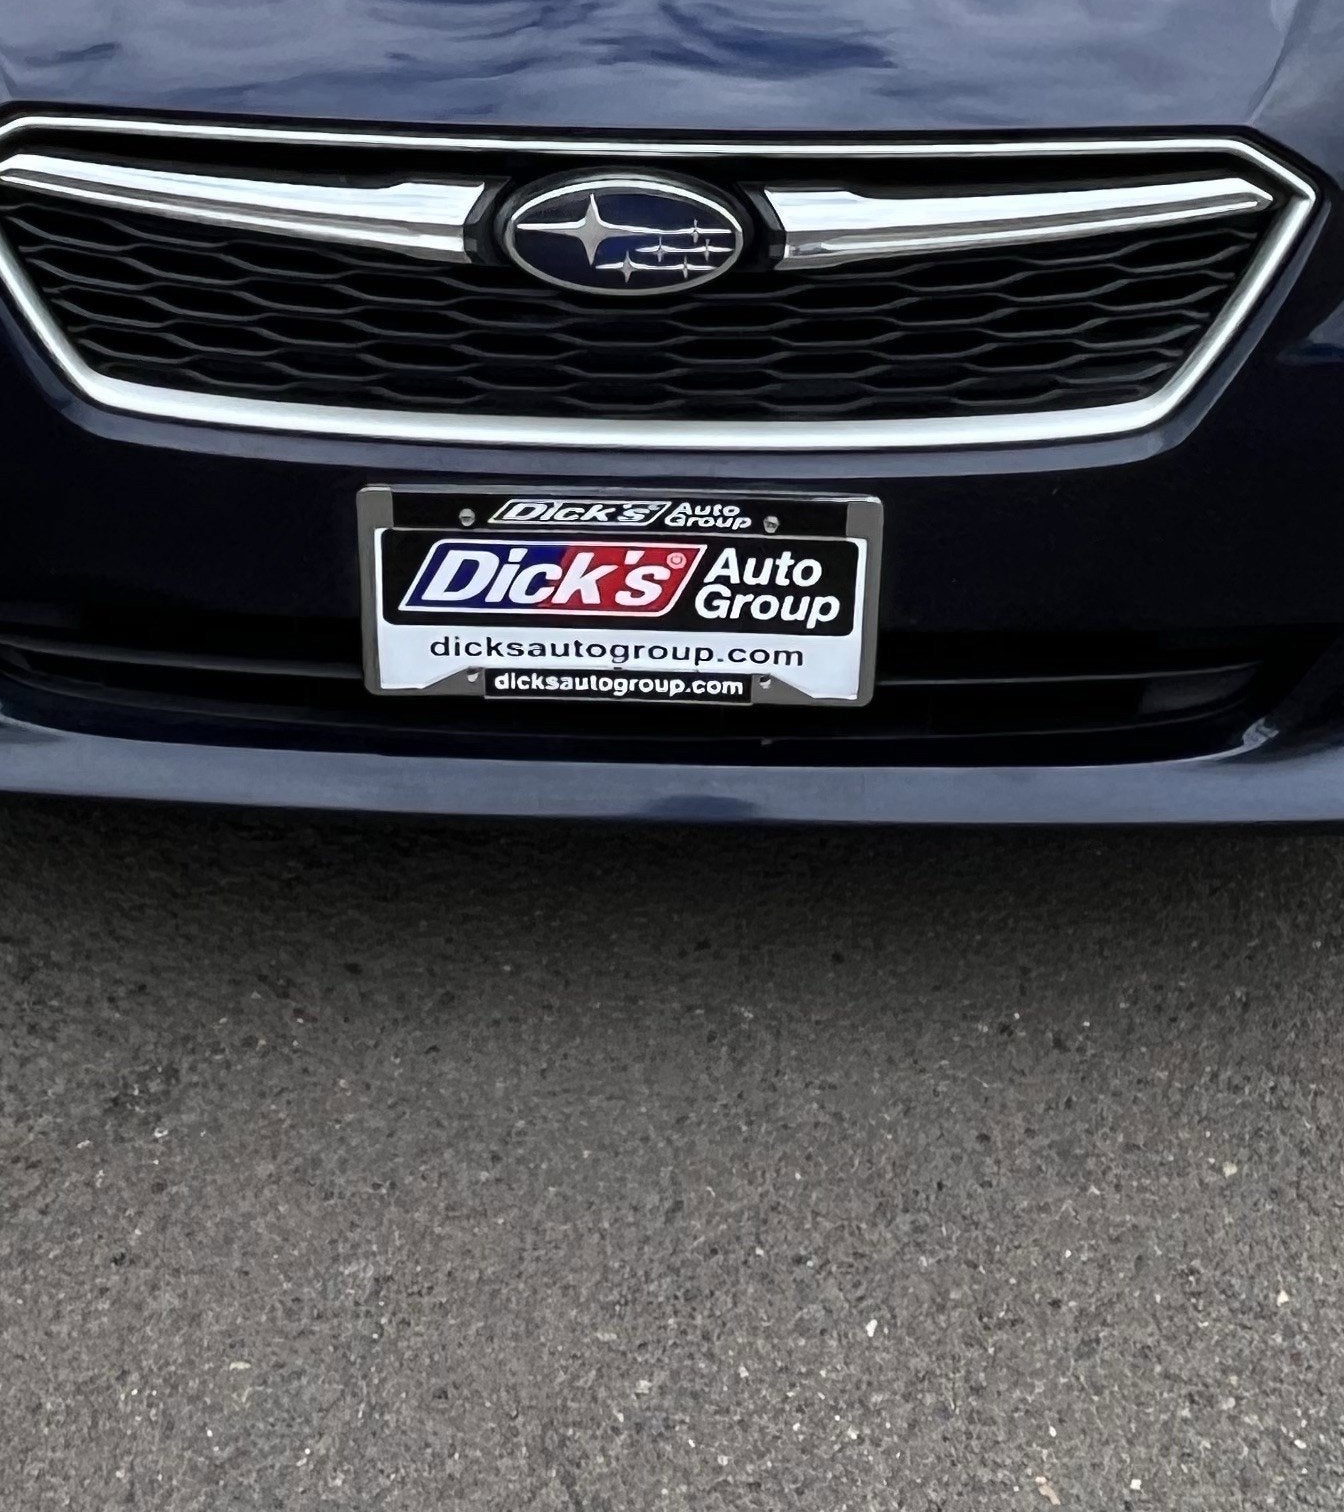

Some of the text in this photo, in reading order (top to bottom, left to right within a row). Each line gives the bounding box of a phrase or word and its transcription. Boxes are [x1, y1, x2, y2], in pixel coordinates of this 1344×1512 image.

[664, 515, 752, 531] Group
[673, 502, 741, 517] Auto
[703, 547, 823, 587] Auto
[694, 583, 841, 629] Group
[430, 635, 805, 666] dicksautogroup.com
[494, 672, 745, 696] dicksautogroup.com
